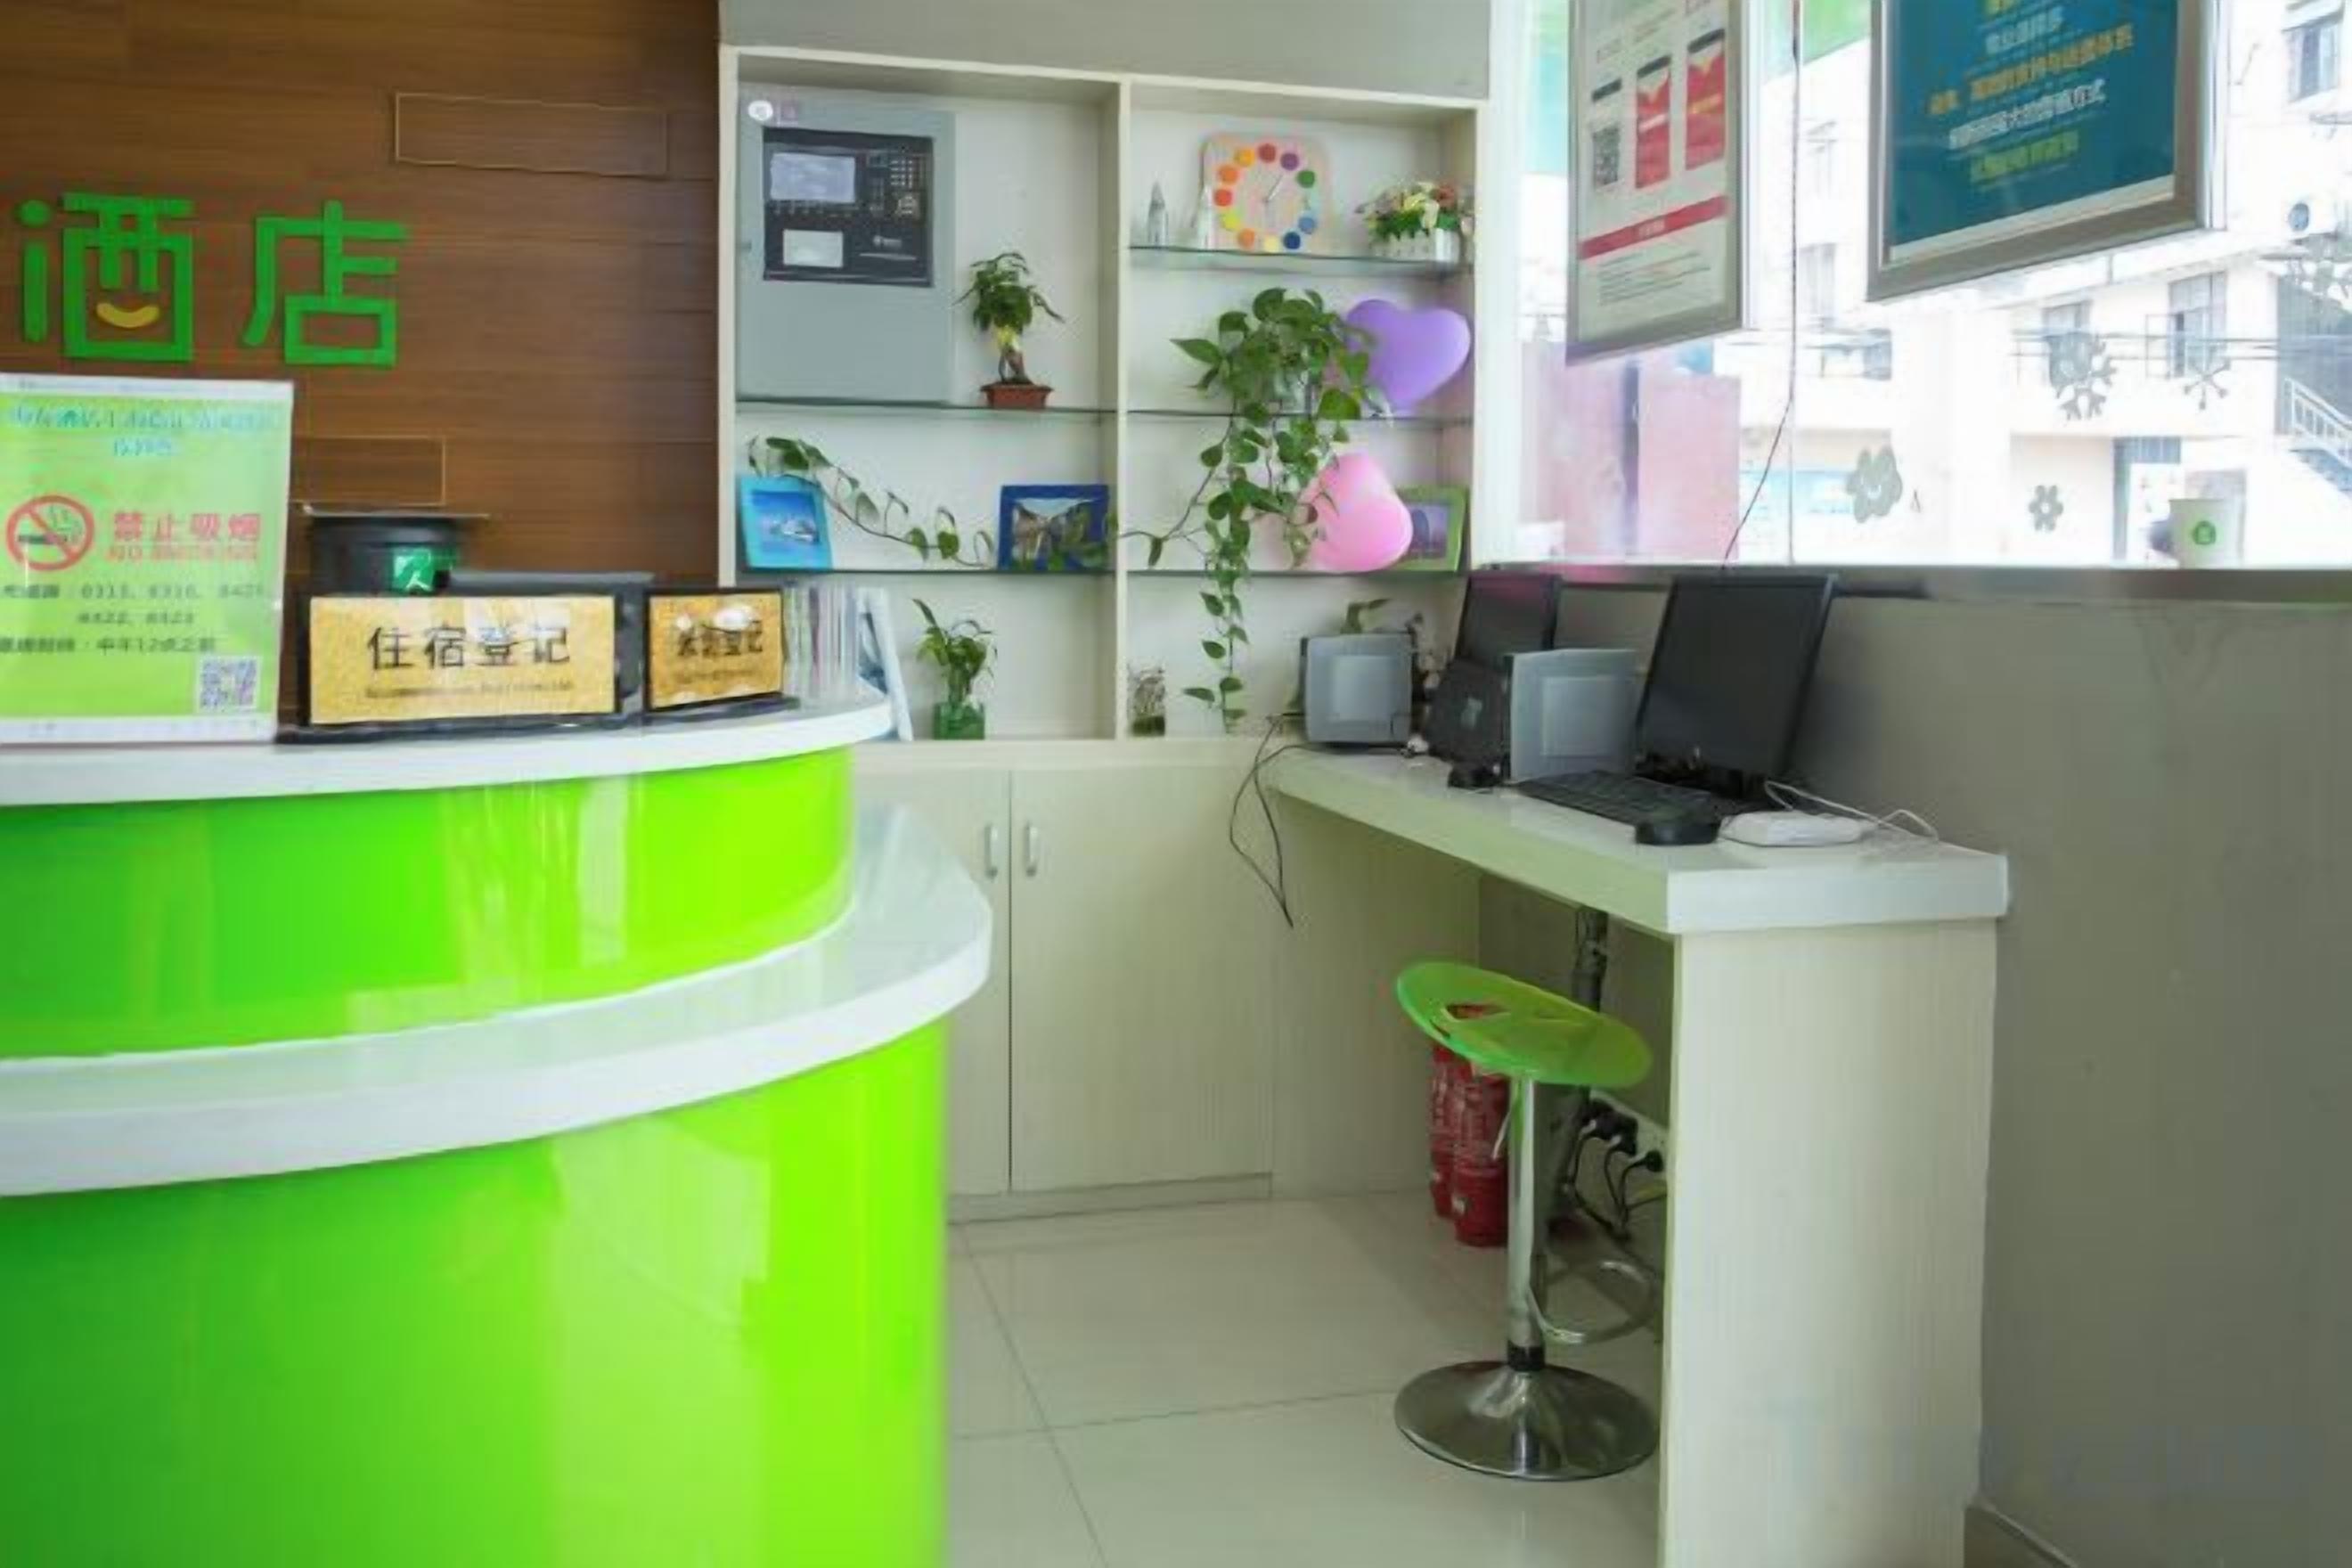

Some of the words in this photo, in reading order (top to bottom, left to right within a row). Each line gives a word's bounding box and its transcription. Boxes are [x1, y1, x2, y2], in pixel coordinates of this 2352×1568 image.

[16, 191, 410, 366] 酒店
[114, 510, 260, 542] 禁止吸烟
[366, 622, 571, 670] 住宿登记
